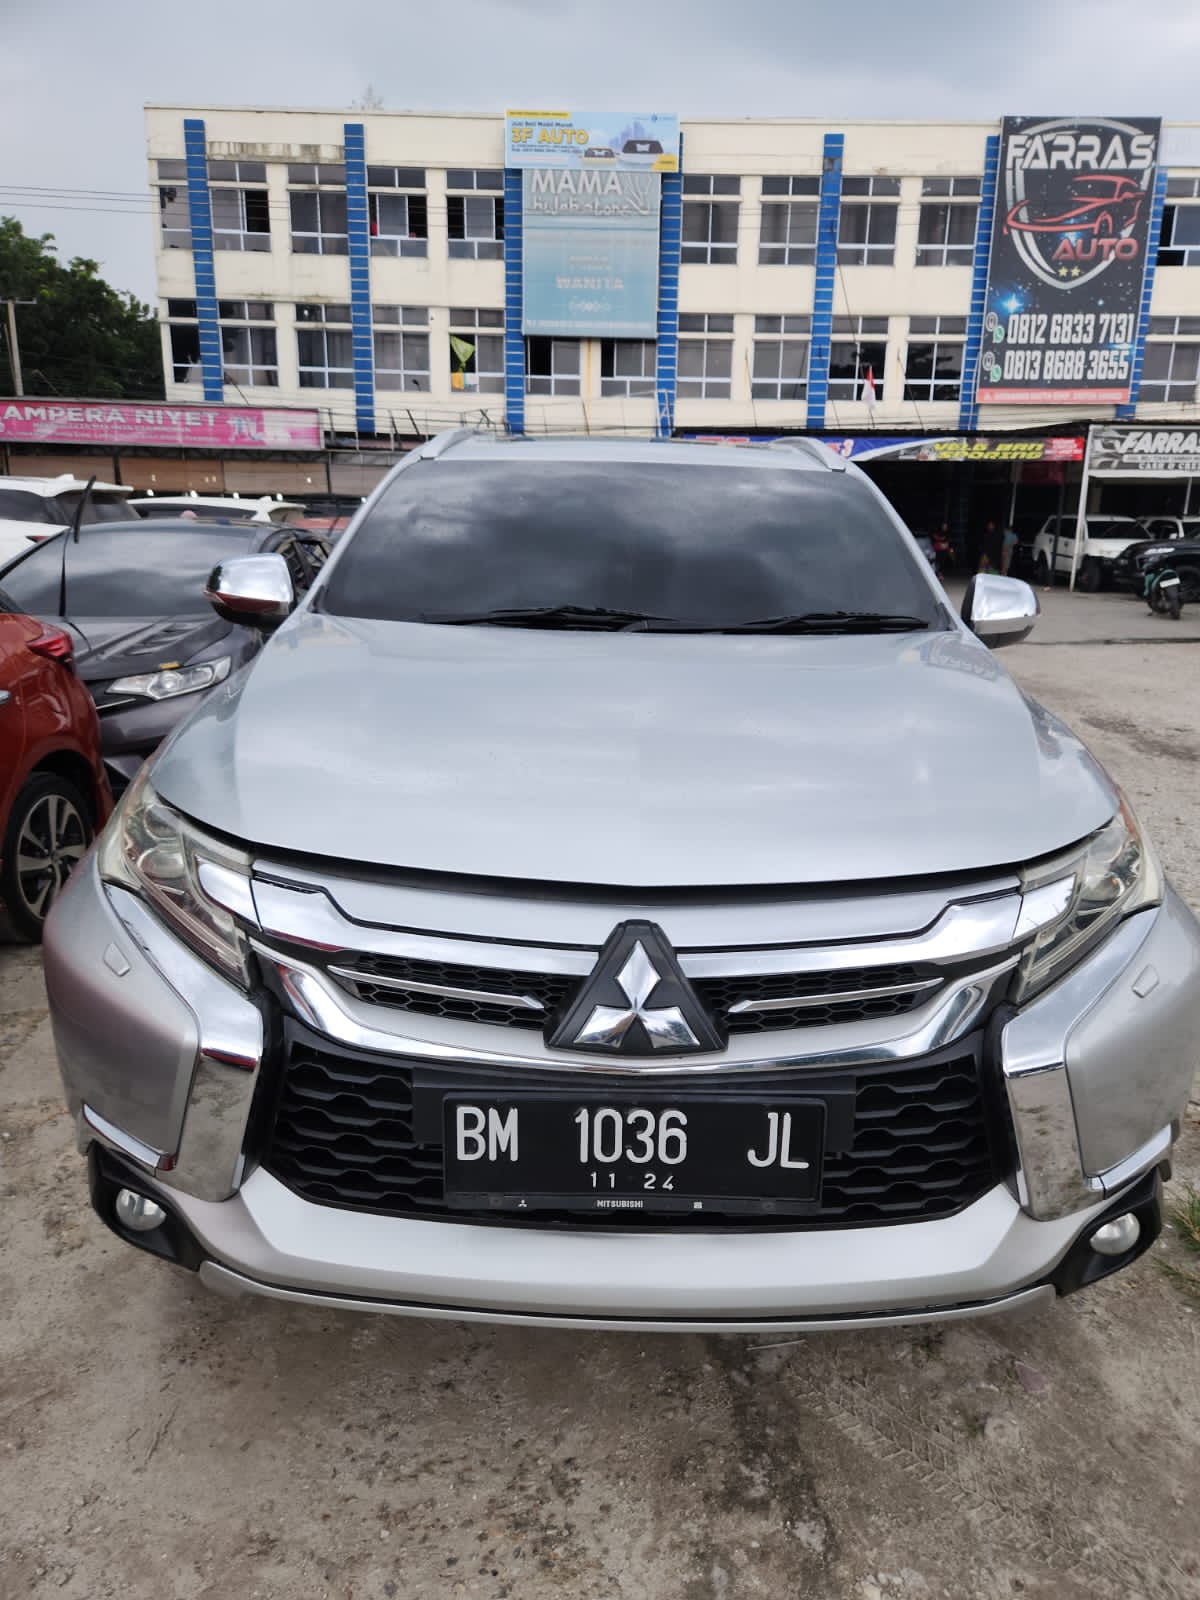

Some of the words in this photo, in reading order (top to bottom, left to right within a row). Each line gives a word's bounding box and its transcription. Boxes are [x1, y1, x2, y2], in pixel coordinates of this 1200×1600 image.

[511, 127, 533, 144] 3F
[537, 128, 590, 145] AUTO
[1006, 133, 1154, 171] FARRAS
[531, 169, 623, 195] MAMA
[1052, 237, 1140, 261] AUTO
[1007, 313, 1048, 345] 0812
[1050, 313, 1094, 345] 6833
[1099, 312, 1135, 344] 7131
[1003, 350, 1042, 381] 0813
[1087, 349, 1130, 380] 3655
[3, 405, 127, 424] AMPERA
[135, 408, 221, 427] NIYET
[995, 442, 1045, 451] BAN
[1119, 432, 1200, 454] FARRA
[456, 1105, 519, 1162] BM
[574, 1107, 689, 1166] 1036
[746, 1111, 810, 1170] JL
[643, 1172, 675, 1192] 24
[596, 1199, 644, 1209] MITSUBISHI
